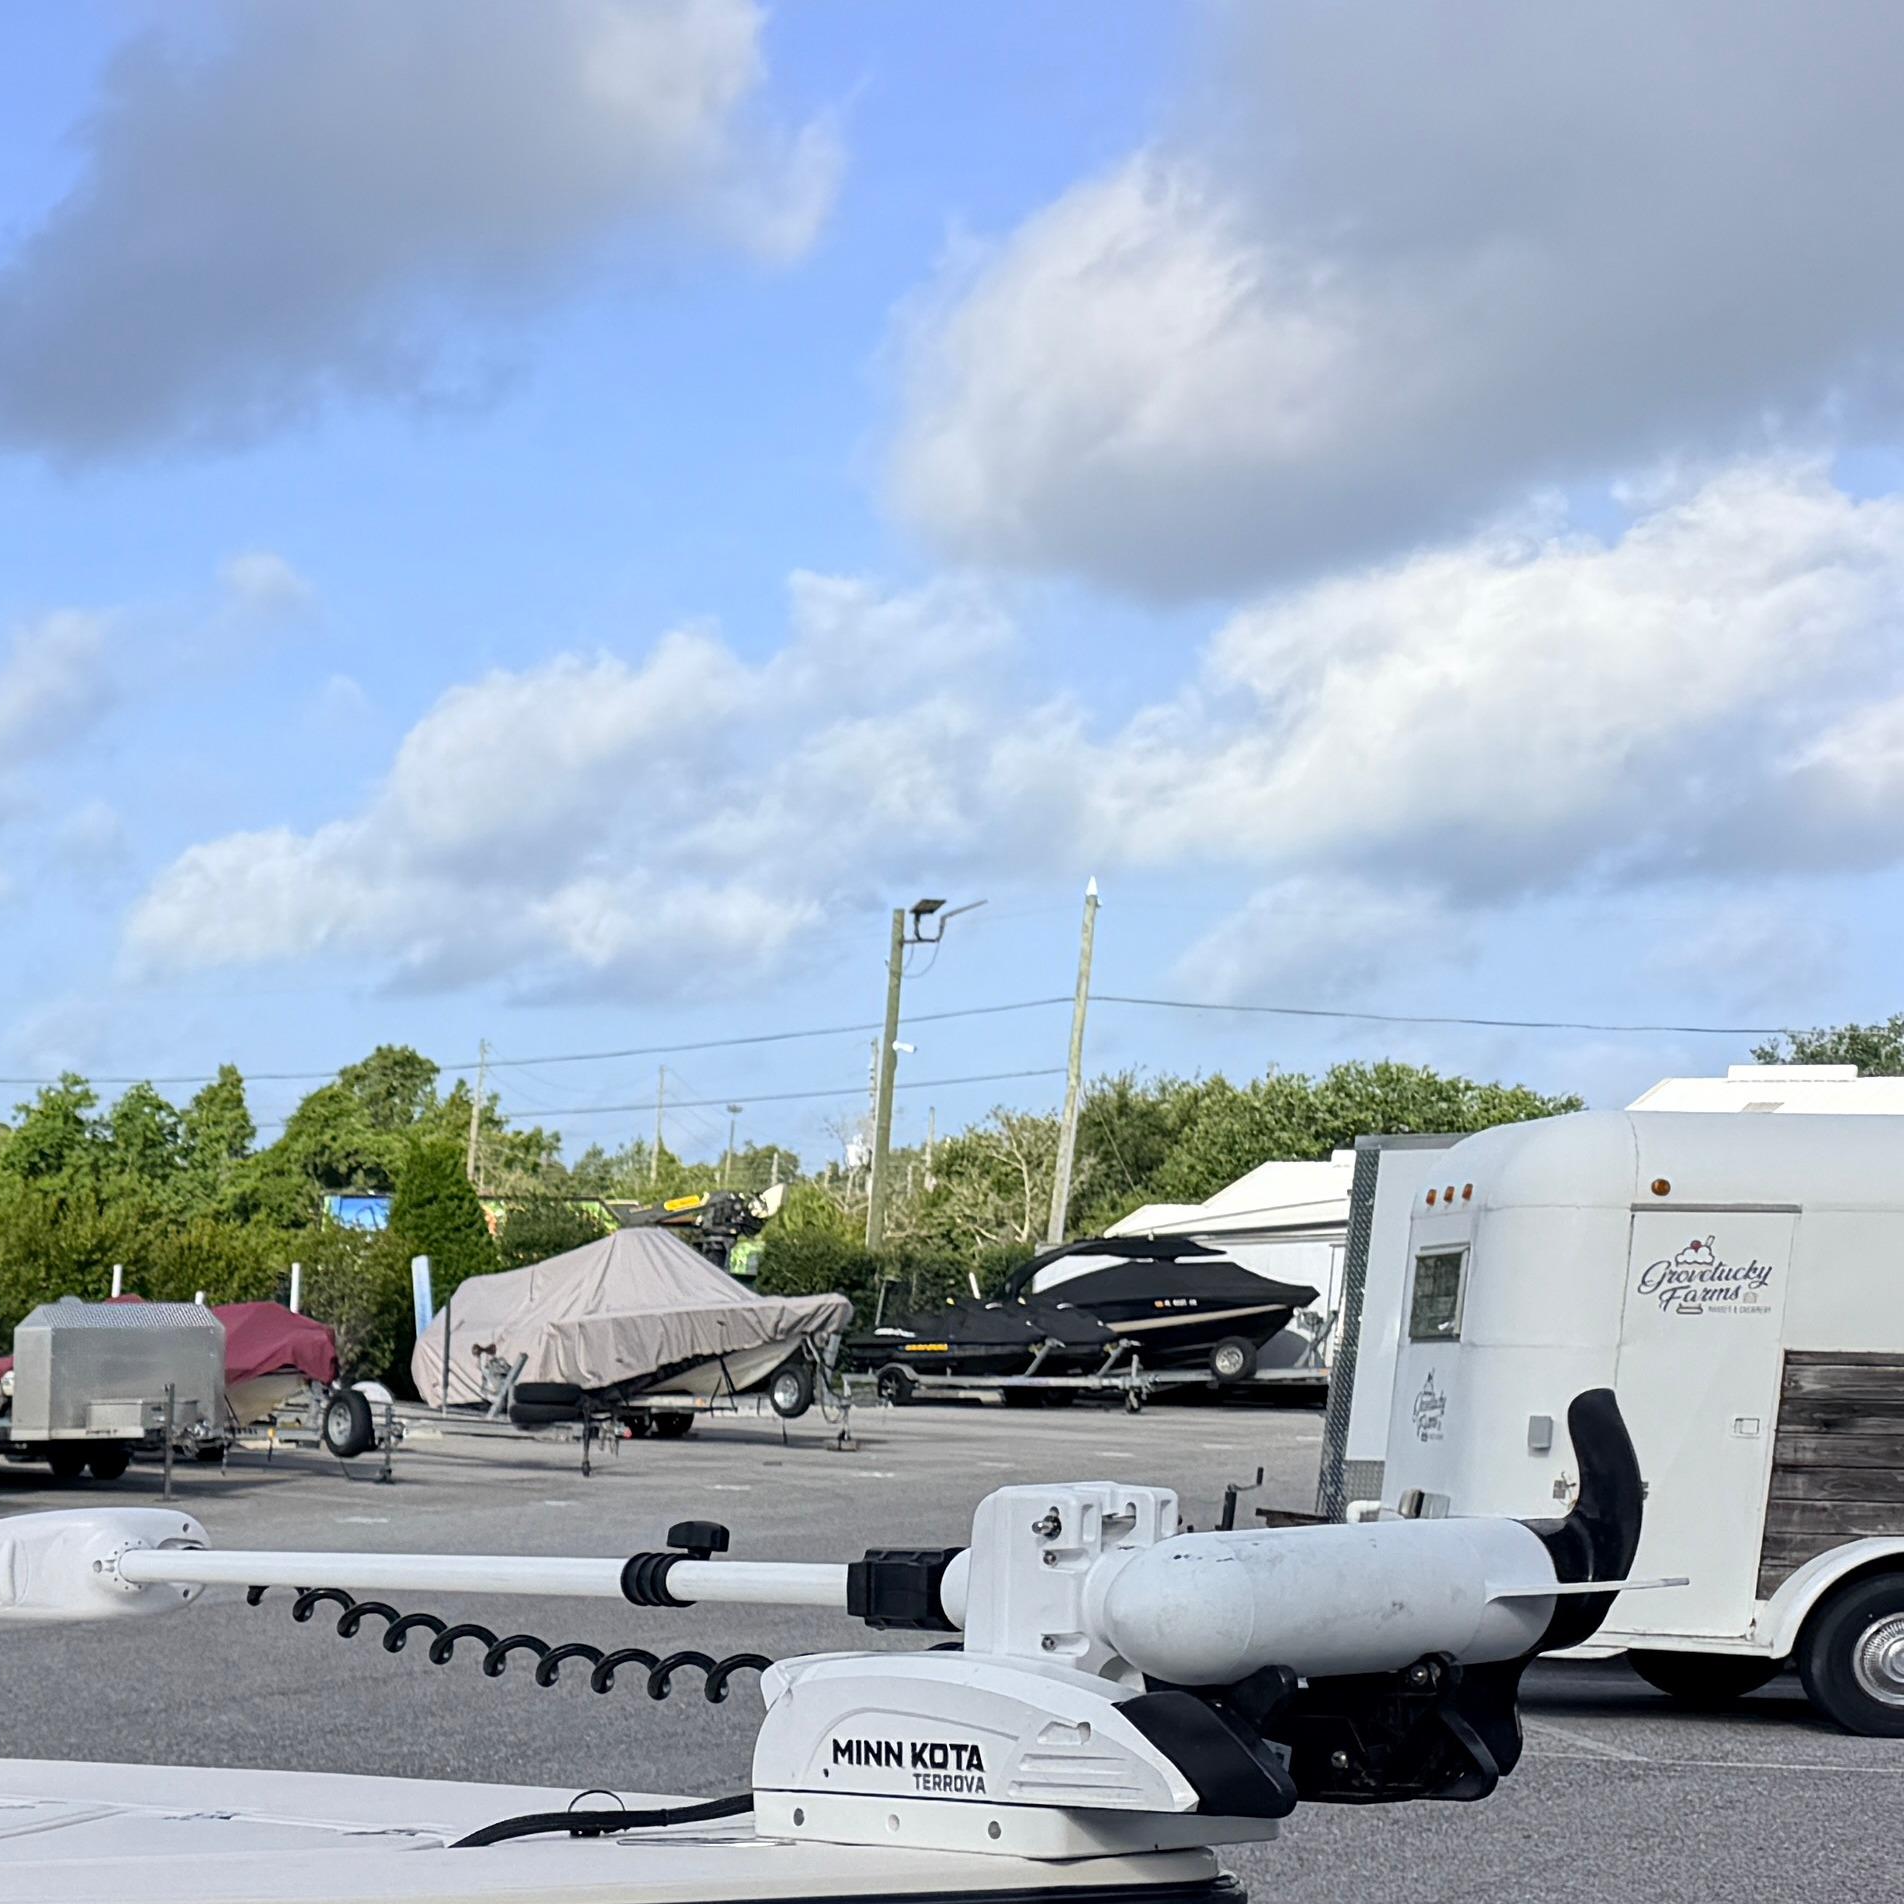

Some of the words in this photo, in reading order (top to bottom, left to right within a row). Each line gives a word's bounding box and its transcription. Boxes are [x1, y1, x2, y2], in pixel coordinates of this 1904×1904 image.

[1658, 1284, 1742, 1312] Farms
[832, 1738, 903, 1768] MINN
[910, 1741, 986, 1772] KOTA
[912, 1772, 987, 1795] TERROVA
